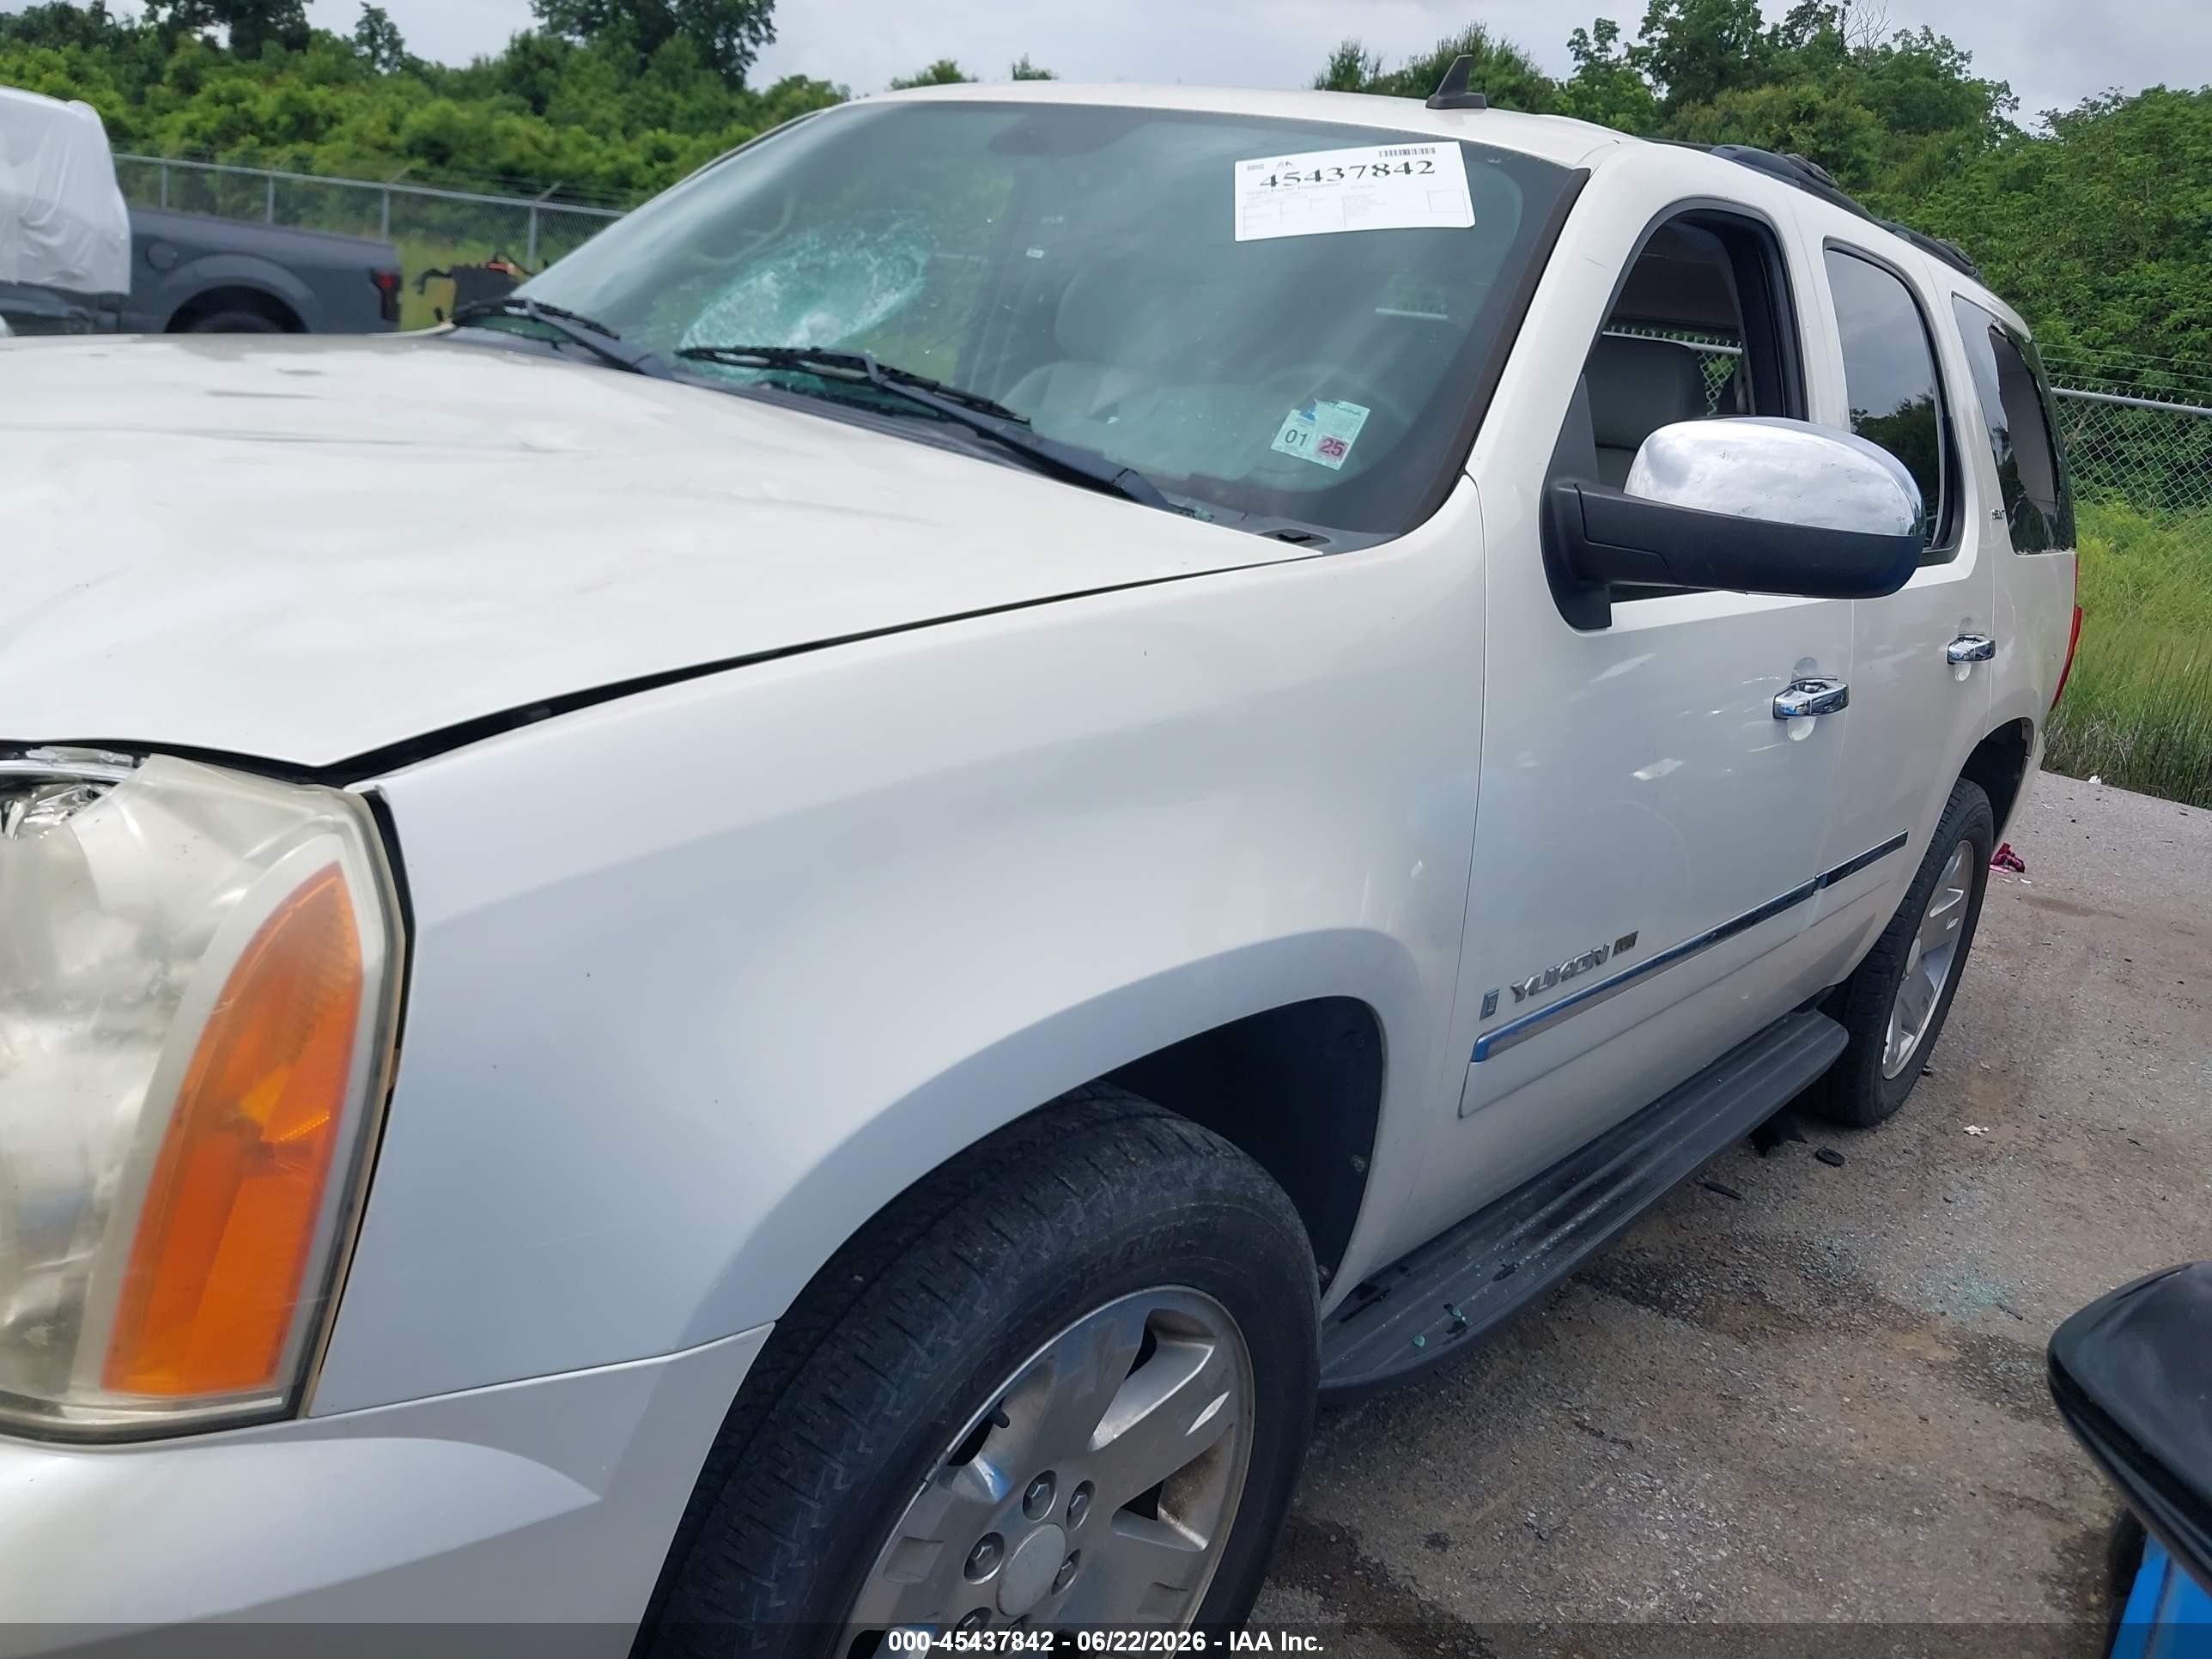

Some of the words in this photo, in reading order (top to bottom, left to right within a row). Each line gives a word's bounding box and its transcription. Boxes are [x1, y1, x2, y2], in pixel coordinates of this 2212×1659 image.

[1260, 160, 1435, 187] 45437842
[1285, 428, 1308, 447] 01
[1319, 437, 1346, 457] 25
[1510, 943, 1611, 1004] YUKON
